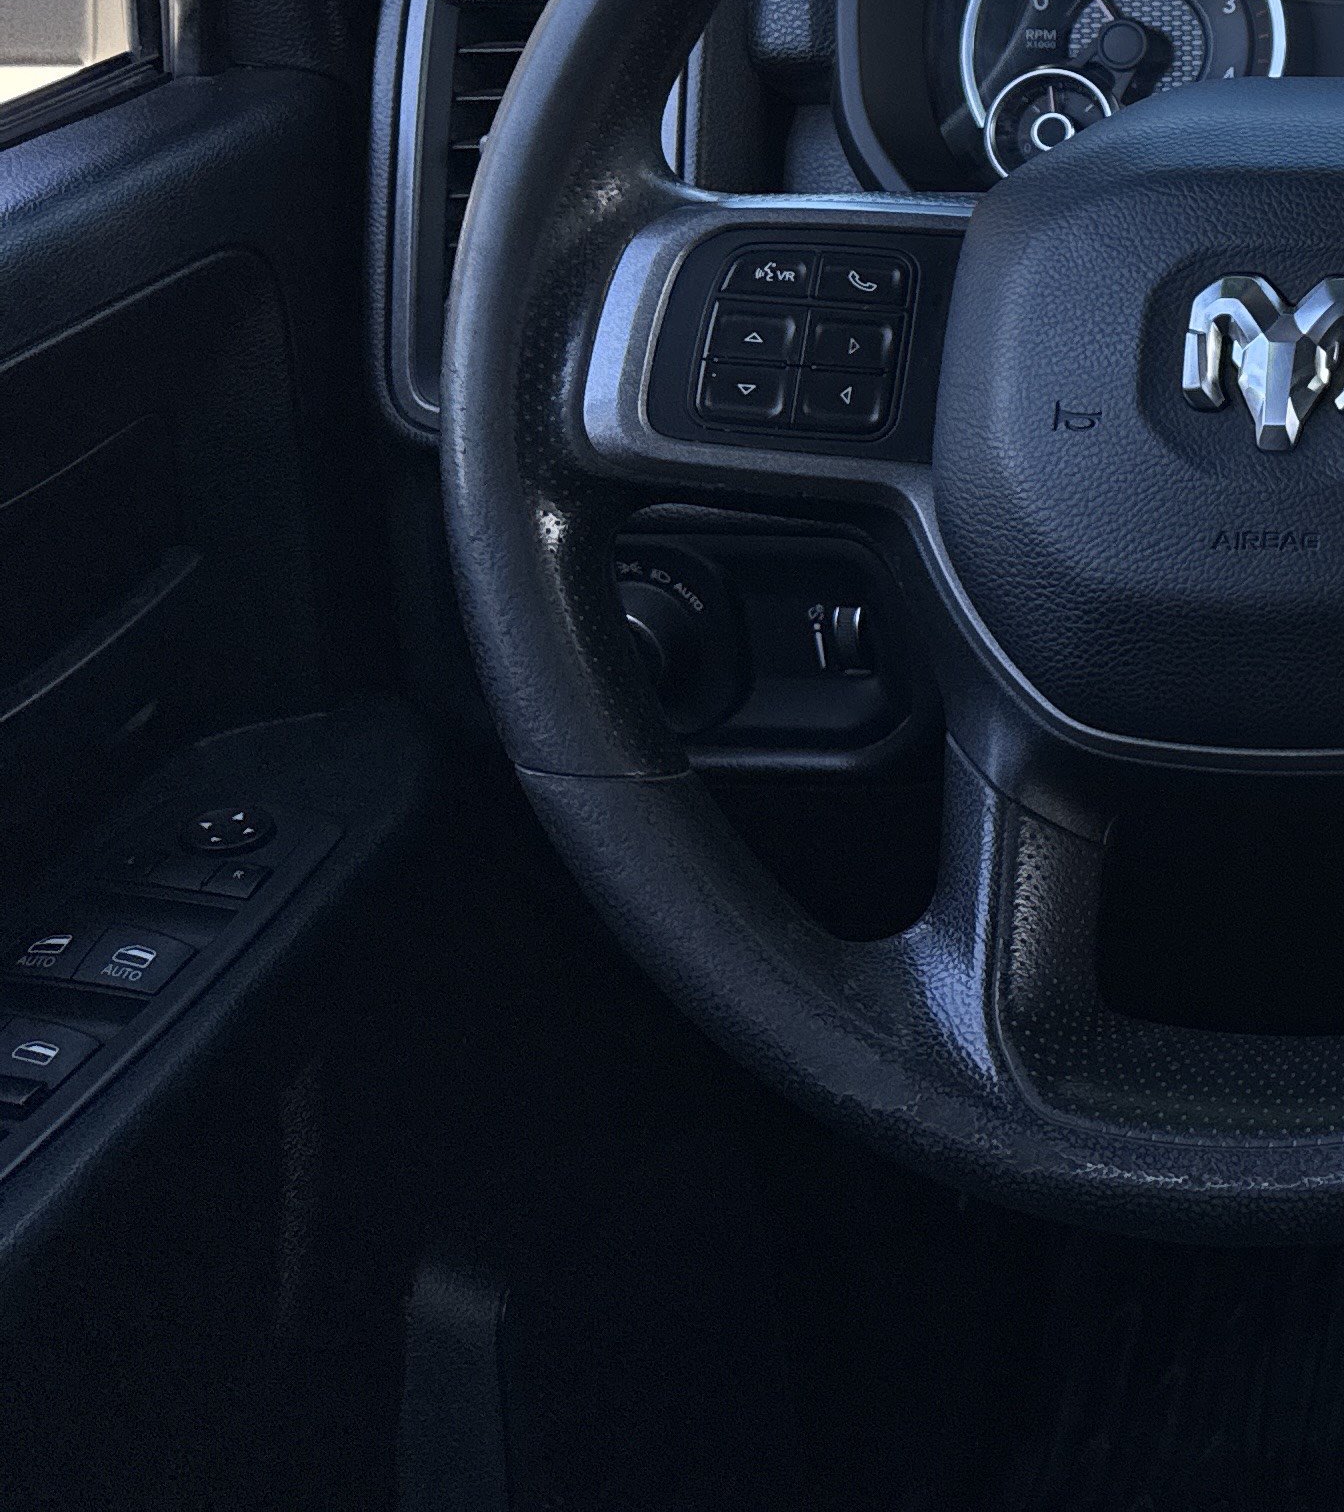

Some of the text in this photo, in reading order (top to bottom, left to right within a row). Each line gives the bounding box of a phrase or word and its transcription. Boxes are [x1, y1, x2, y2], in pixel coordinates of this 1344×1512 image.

[1025, 29, 1057, 41] RPM
[778, 271, 796, 282] VR
[1211, 530, 1321, 551] AIRBAG
[673, 582, 705, 612] AUTO
[17, 956, 57, 969] AUTO
[100, 964, 142, 981] AUTO
